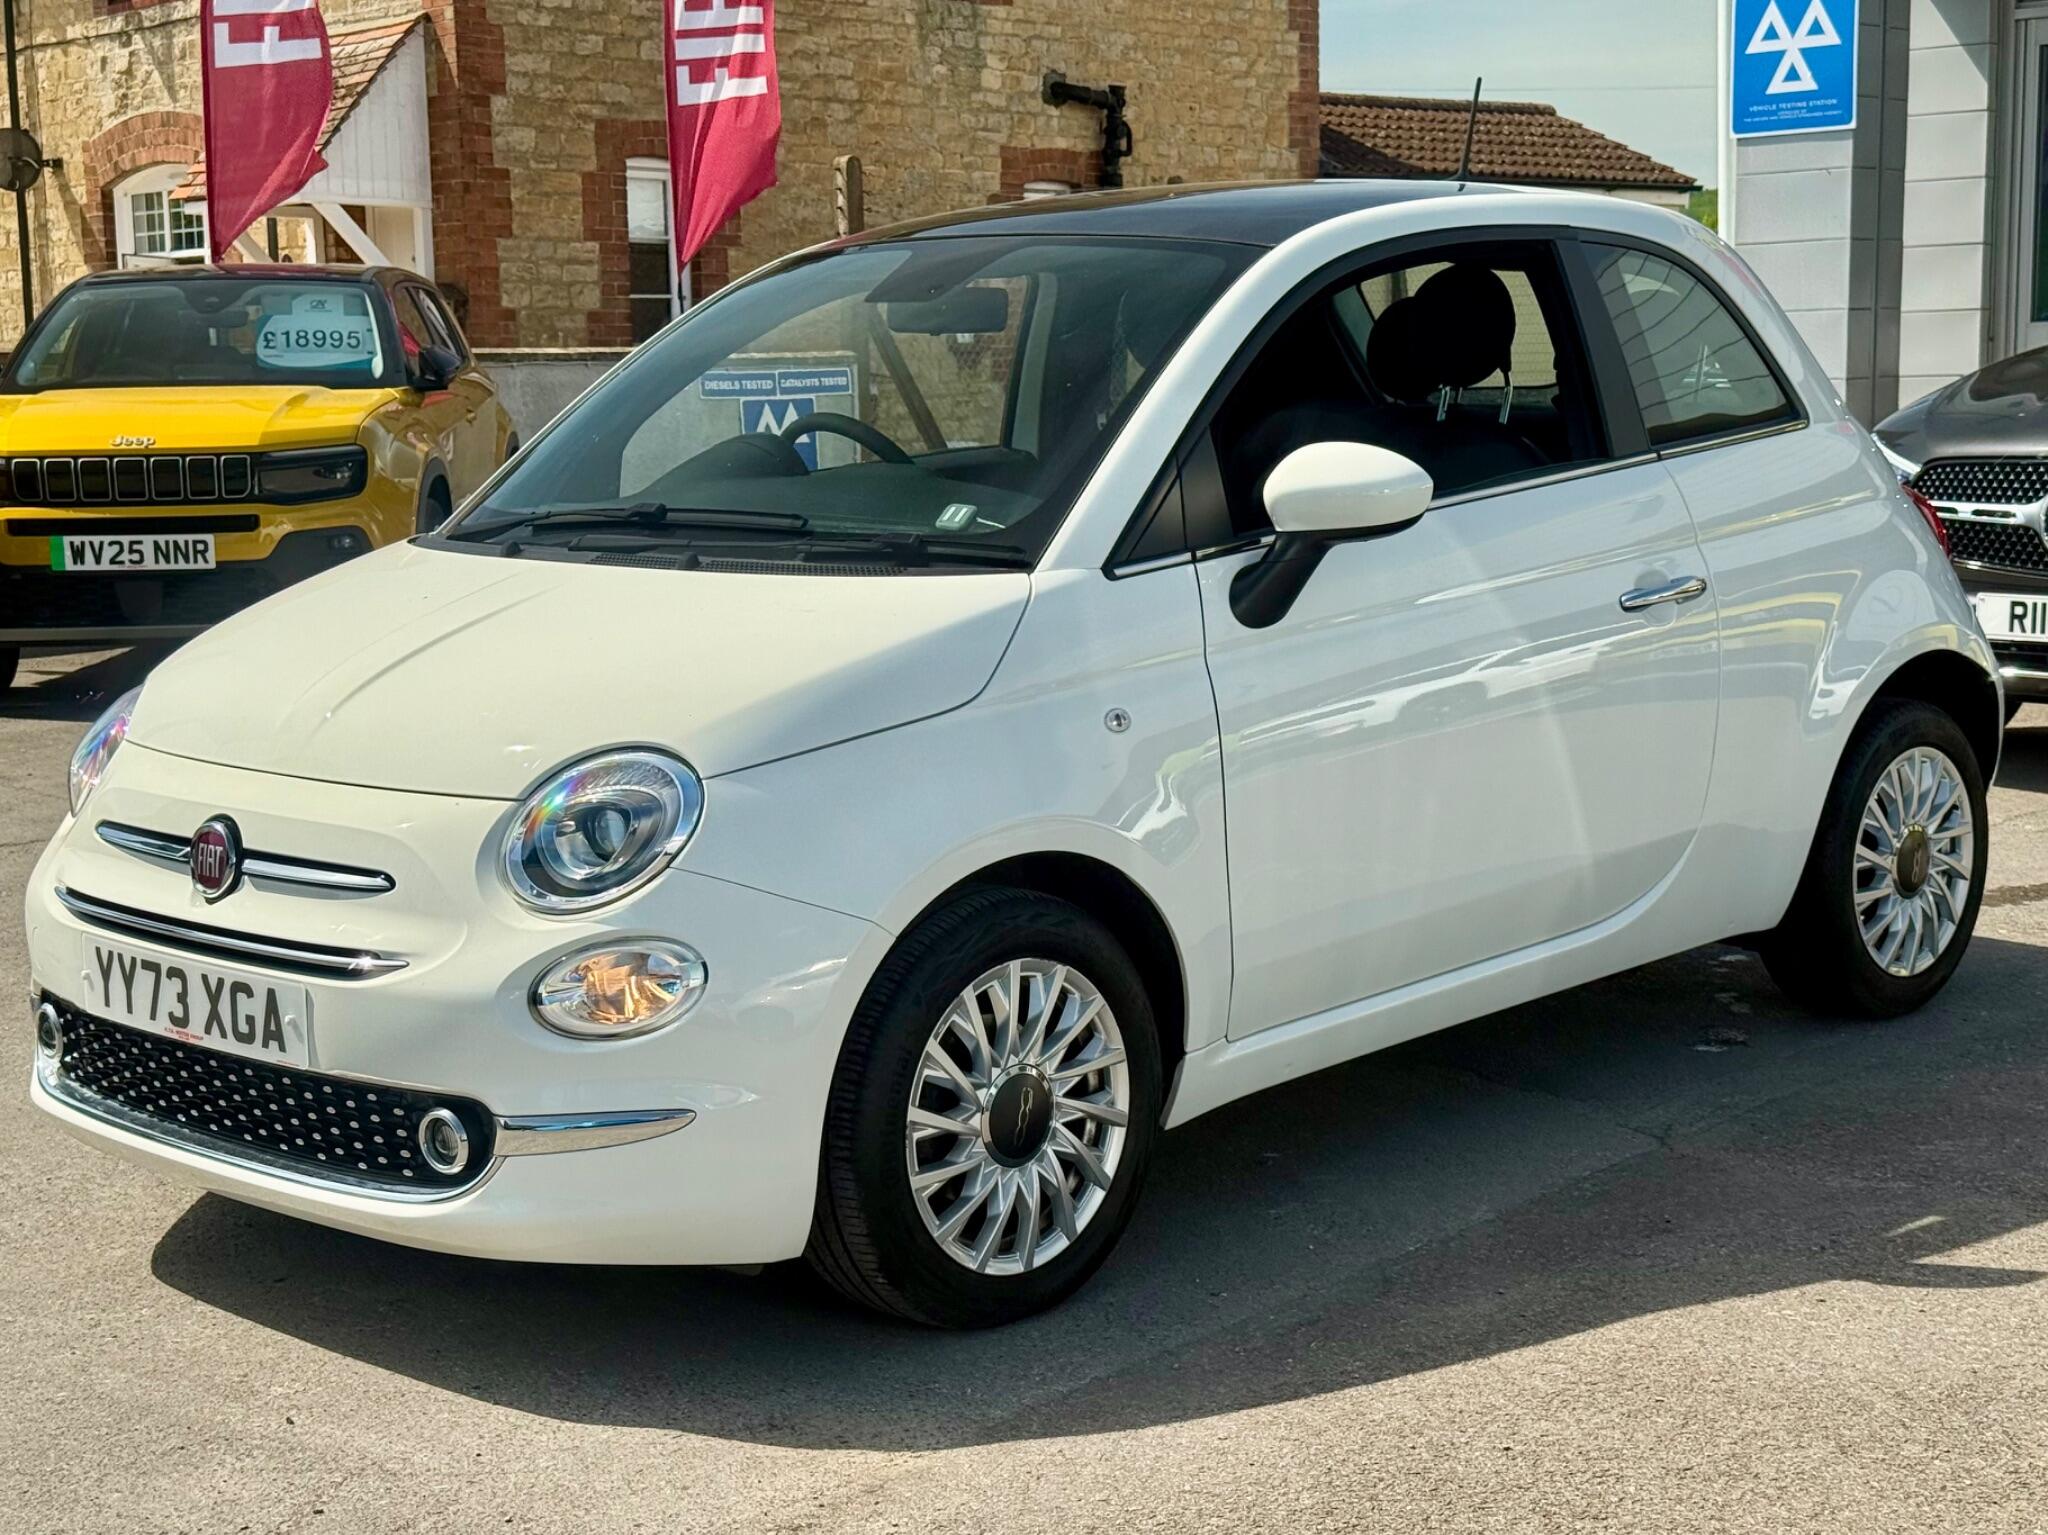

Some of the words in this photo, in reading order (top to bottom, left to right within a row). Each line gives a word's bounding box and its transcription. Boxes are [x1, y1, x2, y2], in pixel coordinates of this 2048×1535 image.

[263, 329, 361, 350] £18995
[704, 380, 741, 390] DIESELS
[742, 380, 774, 390] TESTED
[780, 378, 820, 388] CATALYSTS
[821, 377, 848, 387] TESTED
[111, 434, 156, 449] Jeep
[69, 540, 145, 566] WV25
[152, 539, 210, 565] NNR
[198, 843, 223, 878] FIAT
[95, 946, 190, 1030] YY73
[201, 973, 288, 1053] XGA
